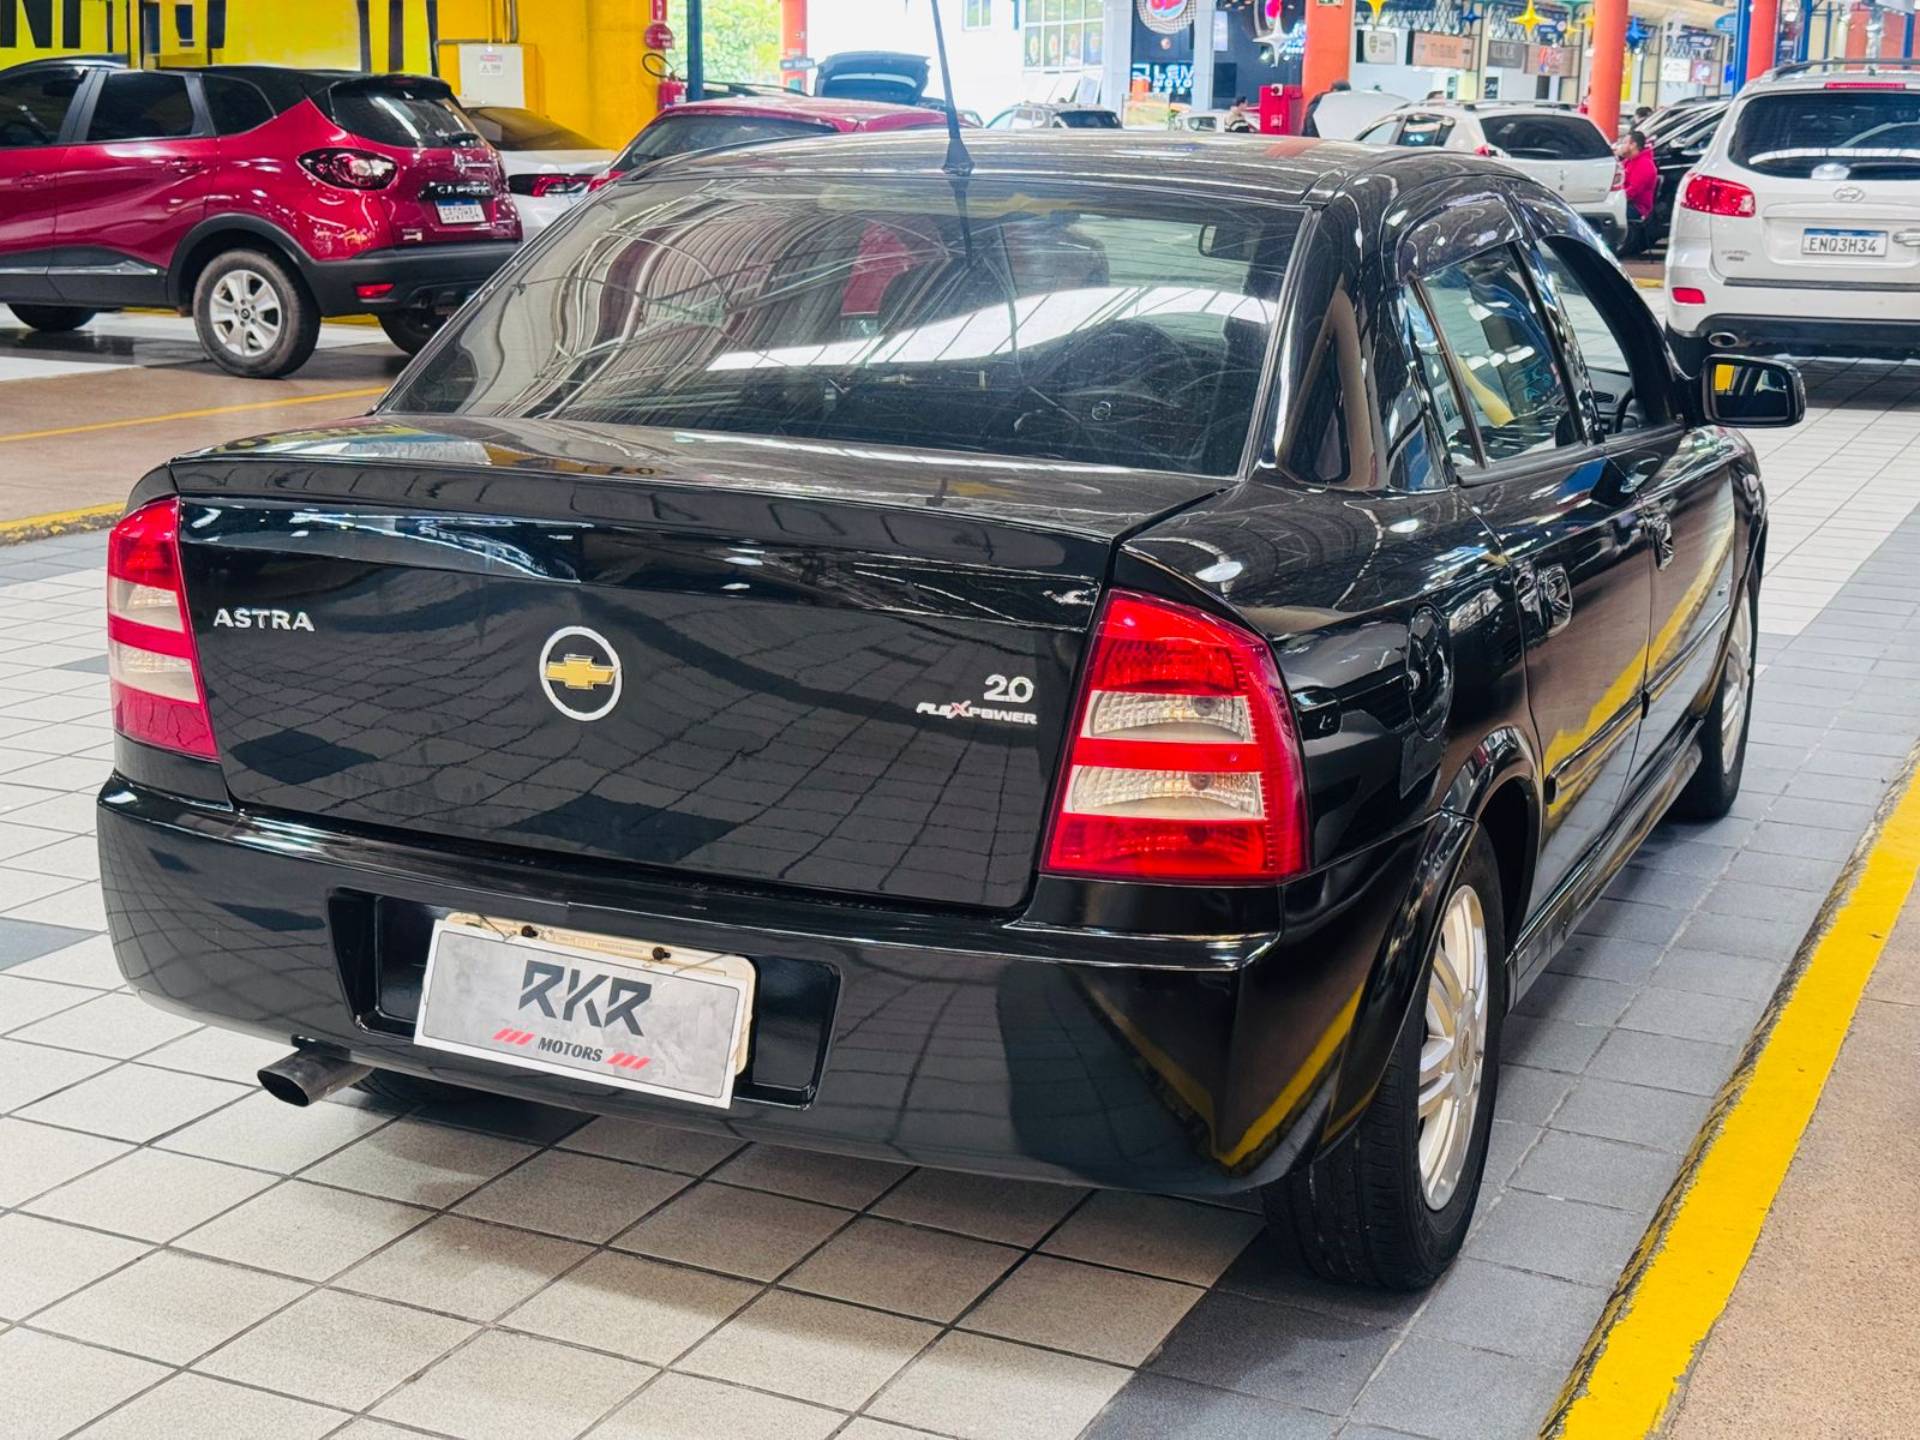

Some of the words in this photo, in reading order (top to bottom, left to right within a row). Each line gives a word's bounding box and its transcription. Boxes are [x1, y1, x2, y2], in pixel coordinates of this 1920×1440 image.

[213, 607, 316, 632] ASTRA
[518, 959, 652, 1037] RKR
[538, 1037, 603, 1063] MOTORS
